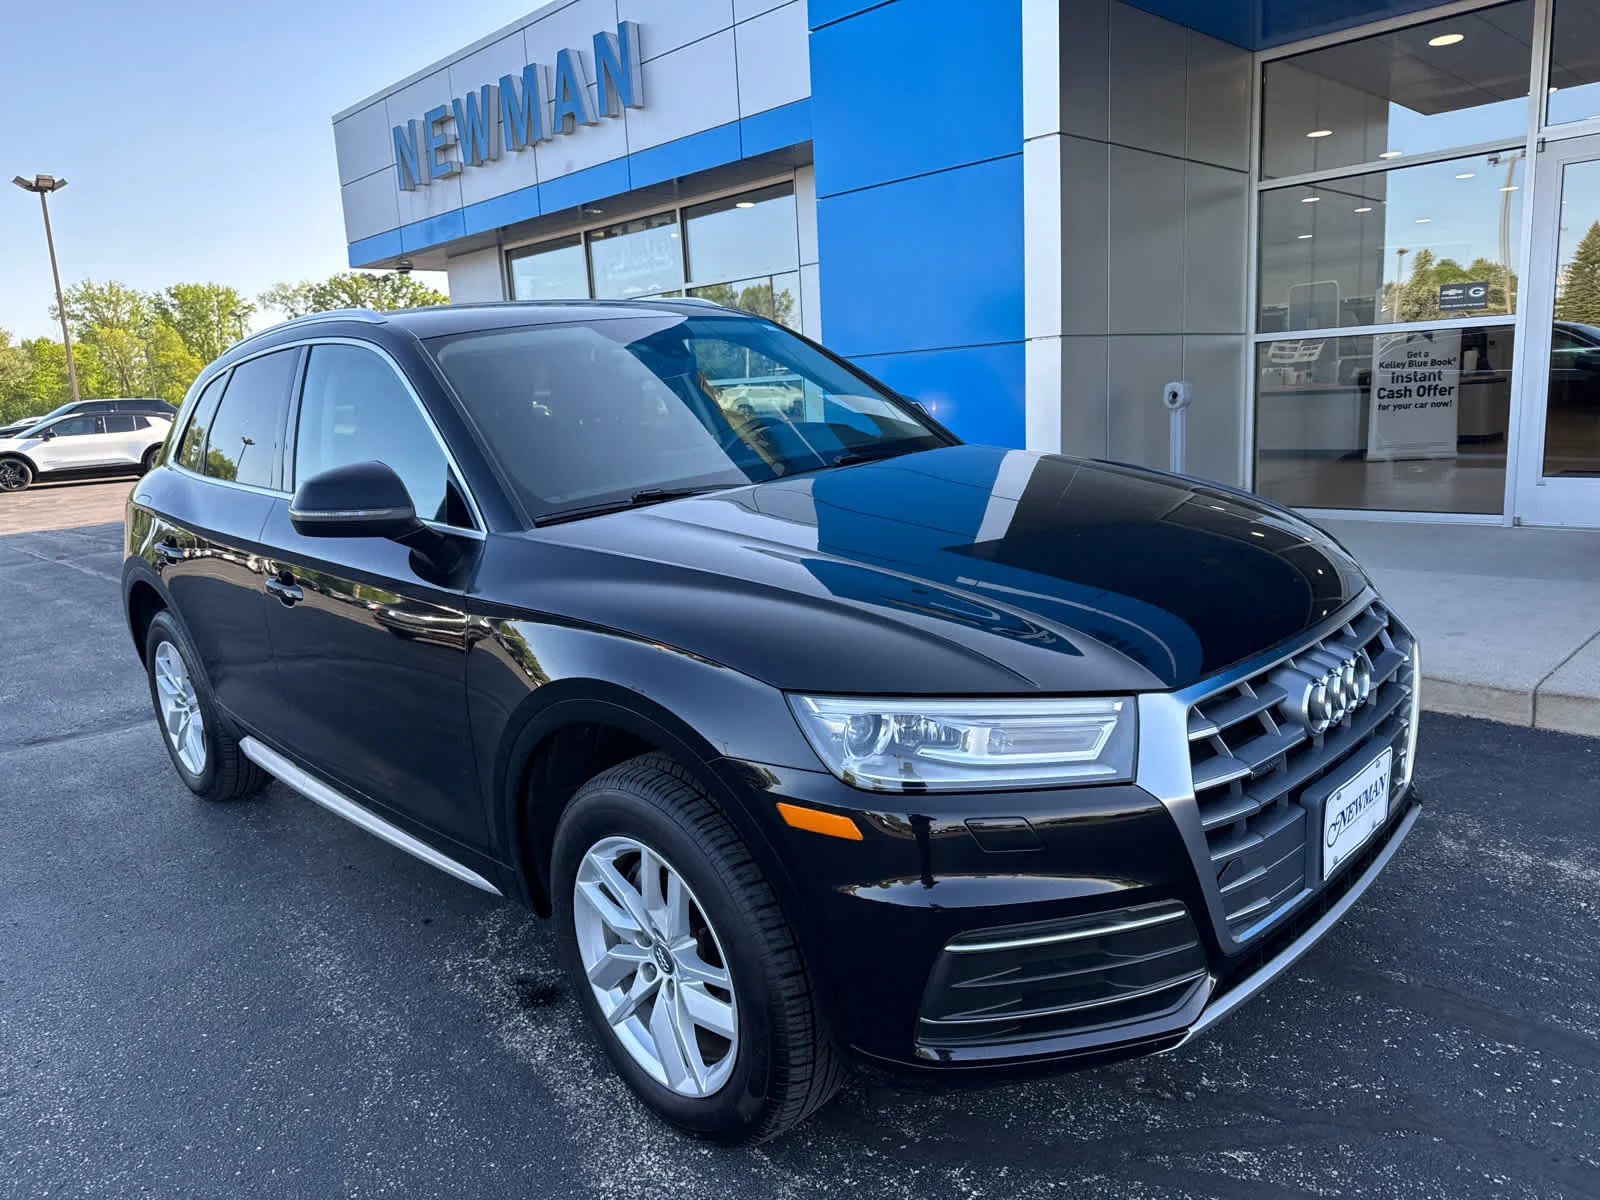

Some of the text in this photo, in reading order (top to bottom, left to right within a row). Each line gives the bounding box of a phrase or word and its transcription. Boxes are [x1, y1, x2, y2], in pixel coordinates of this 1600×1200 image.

[393, 21, 644, 191] NEWMAN
[1407, 351, 1422, 359] Get
[1379, 361, 1406, 370] Kelley
[1408, 359, 1428, 368] Blue
[1377, 384, 1455, 399] Cash Offer
[1377, 403, 1390, 411] for
[1392, 403, 1412, 412] your
[1430, 400, 1453, 409] now!
[1327, 773, 1387, 848] NEWMAN
